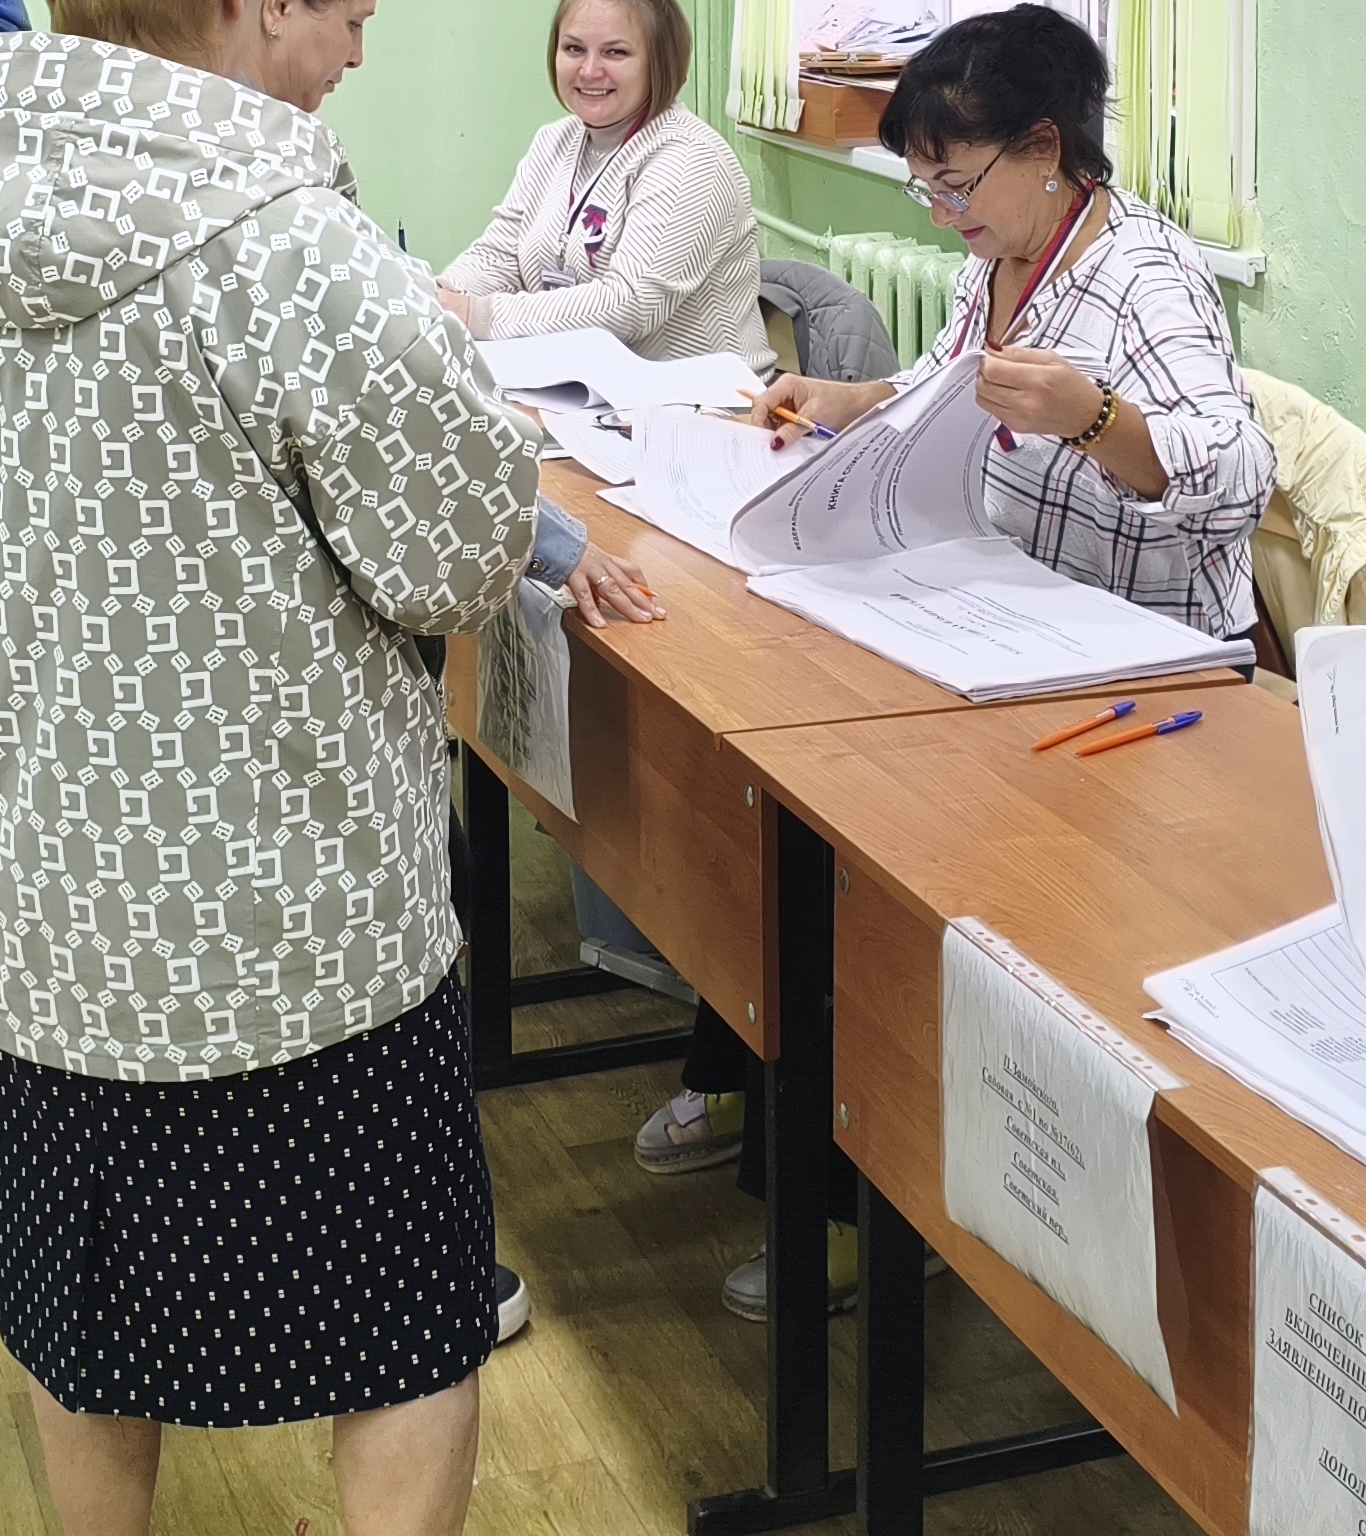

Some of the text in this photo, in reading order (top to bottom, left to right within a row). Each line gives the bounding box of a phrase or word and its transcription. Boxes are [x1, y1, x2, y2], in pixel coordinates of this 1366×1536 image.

[828, 476, 847, 510] КНИГА
[982, 1066, 1014, 1102] Садовая
[1039, 1116, 1049, 1133] по
[1006, 1114, 1049, 1162] Советская
[1003, 1172, 1047, 1223] Советский
[1309, 1292, 1364, 1346] СПИСОК
[1268, 1327, 1345, 1402] ЗАЯВЛЕНИЯ
